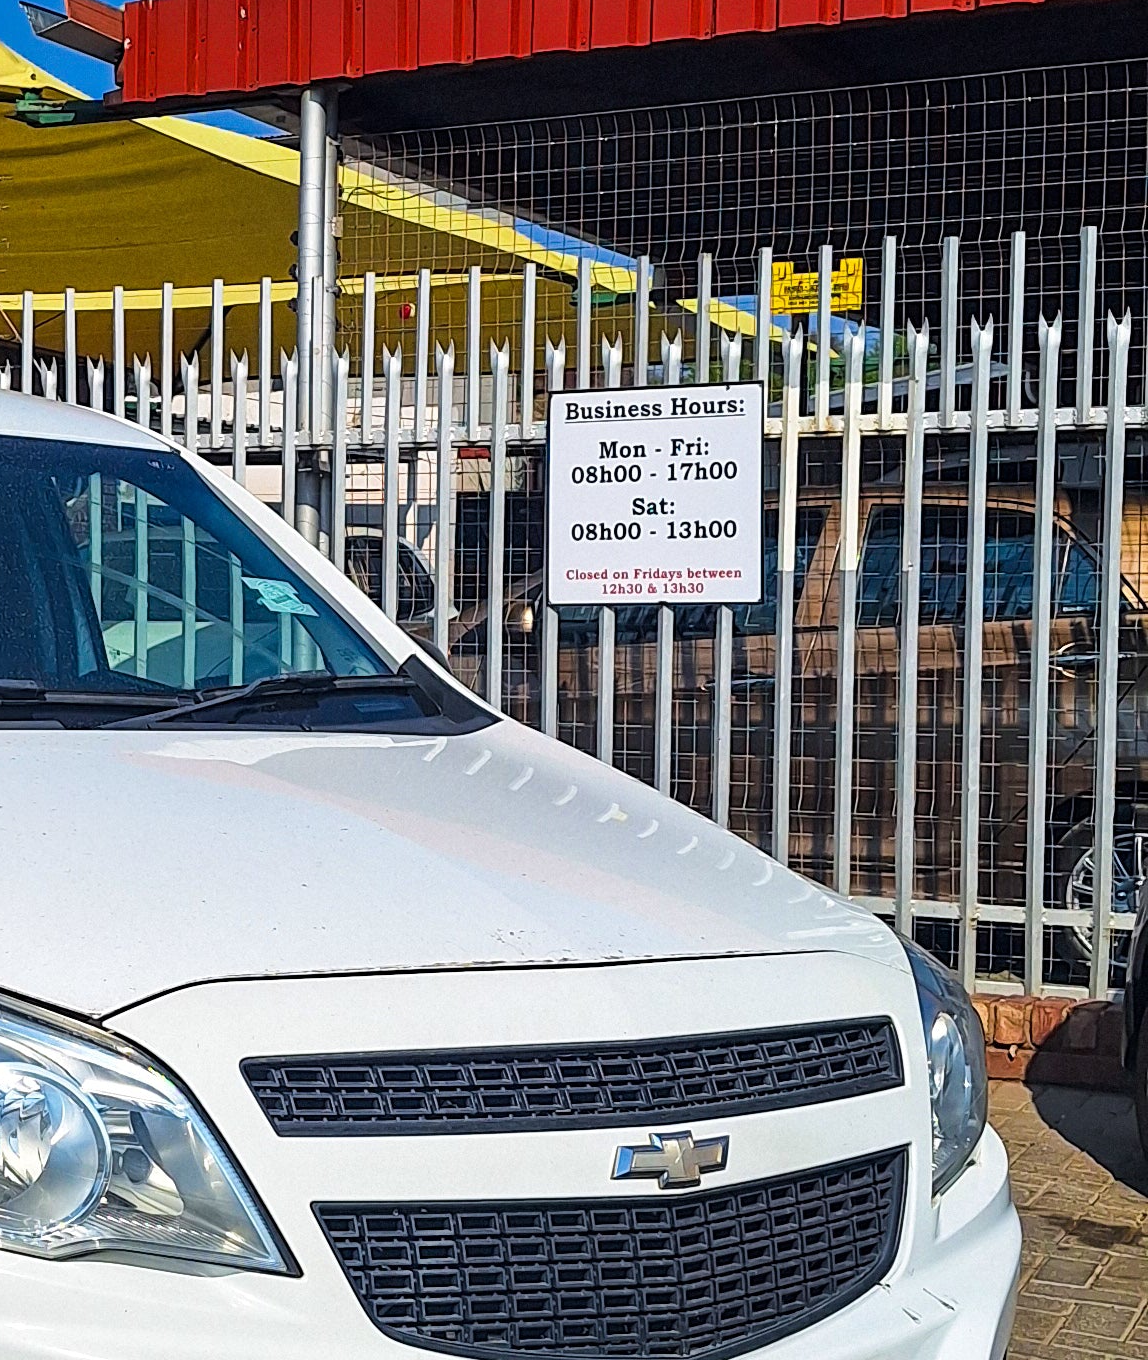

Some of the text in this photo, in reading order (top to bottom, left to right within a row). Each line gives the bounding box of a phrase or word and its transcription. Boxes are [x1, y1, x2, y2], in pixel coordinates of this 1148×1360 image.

[565, 397, 746, 421] Business Hours:
[599, 440, 647, 459] Mon
[670, 437, 709, 457] Fri:
[571, 464, 642, 484] 08h00
[667, 460, 738, 481] 17h00
[632, 497, 675, 515] Sat:
[571, 522, 641, 541] 08h00
[666, 519, 737, 540] 13h00
[565, 567, 742, 581] Closed on Fridays between
[602, 583, 704, 595] 12h30 & 13h30
